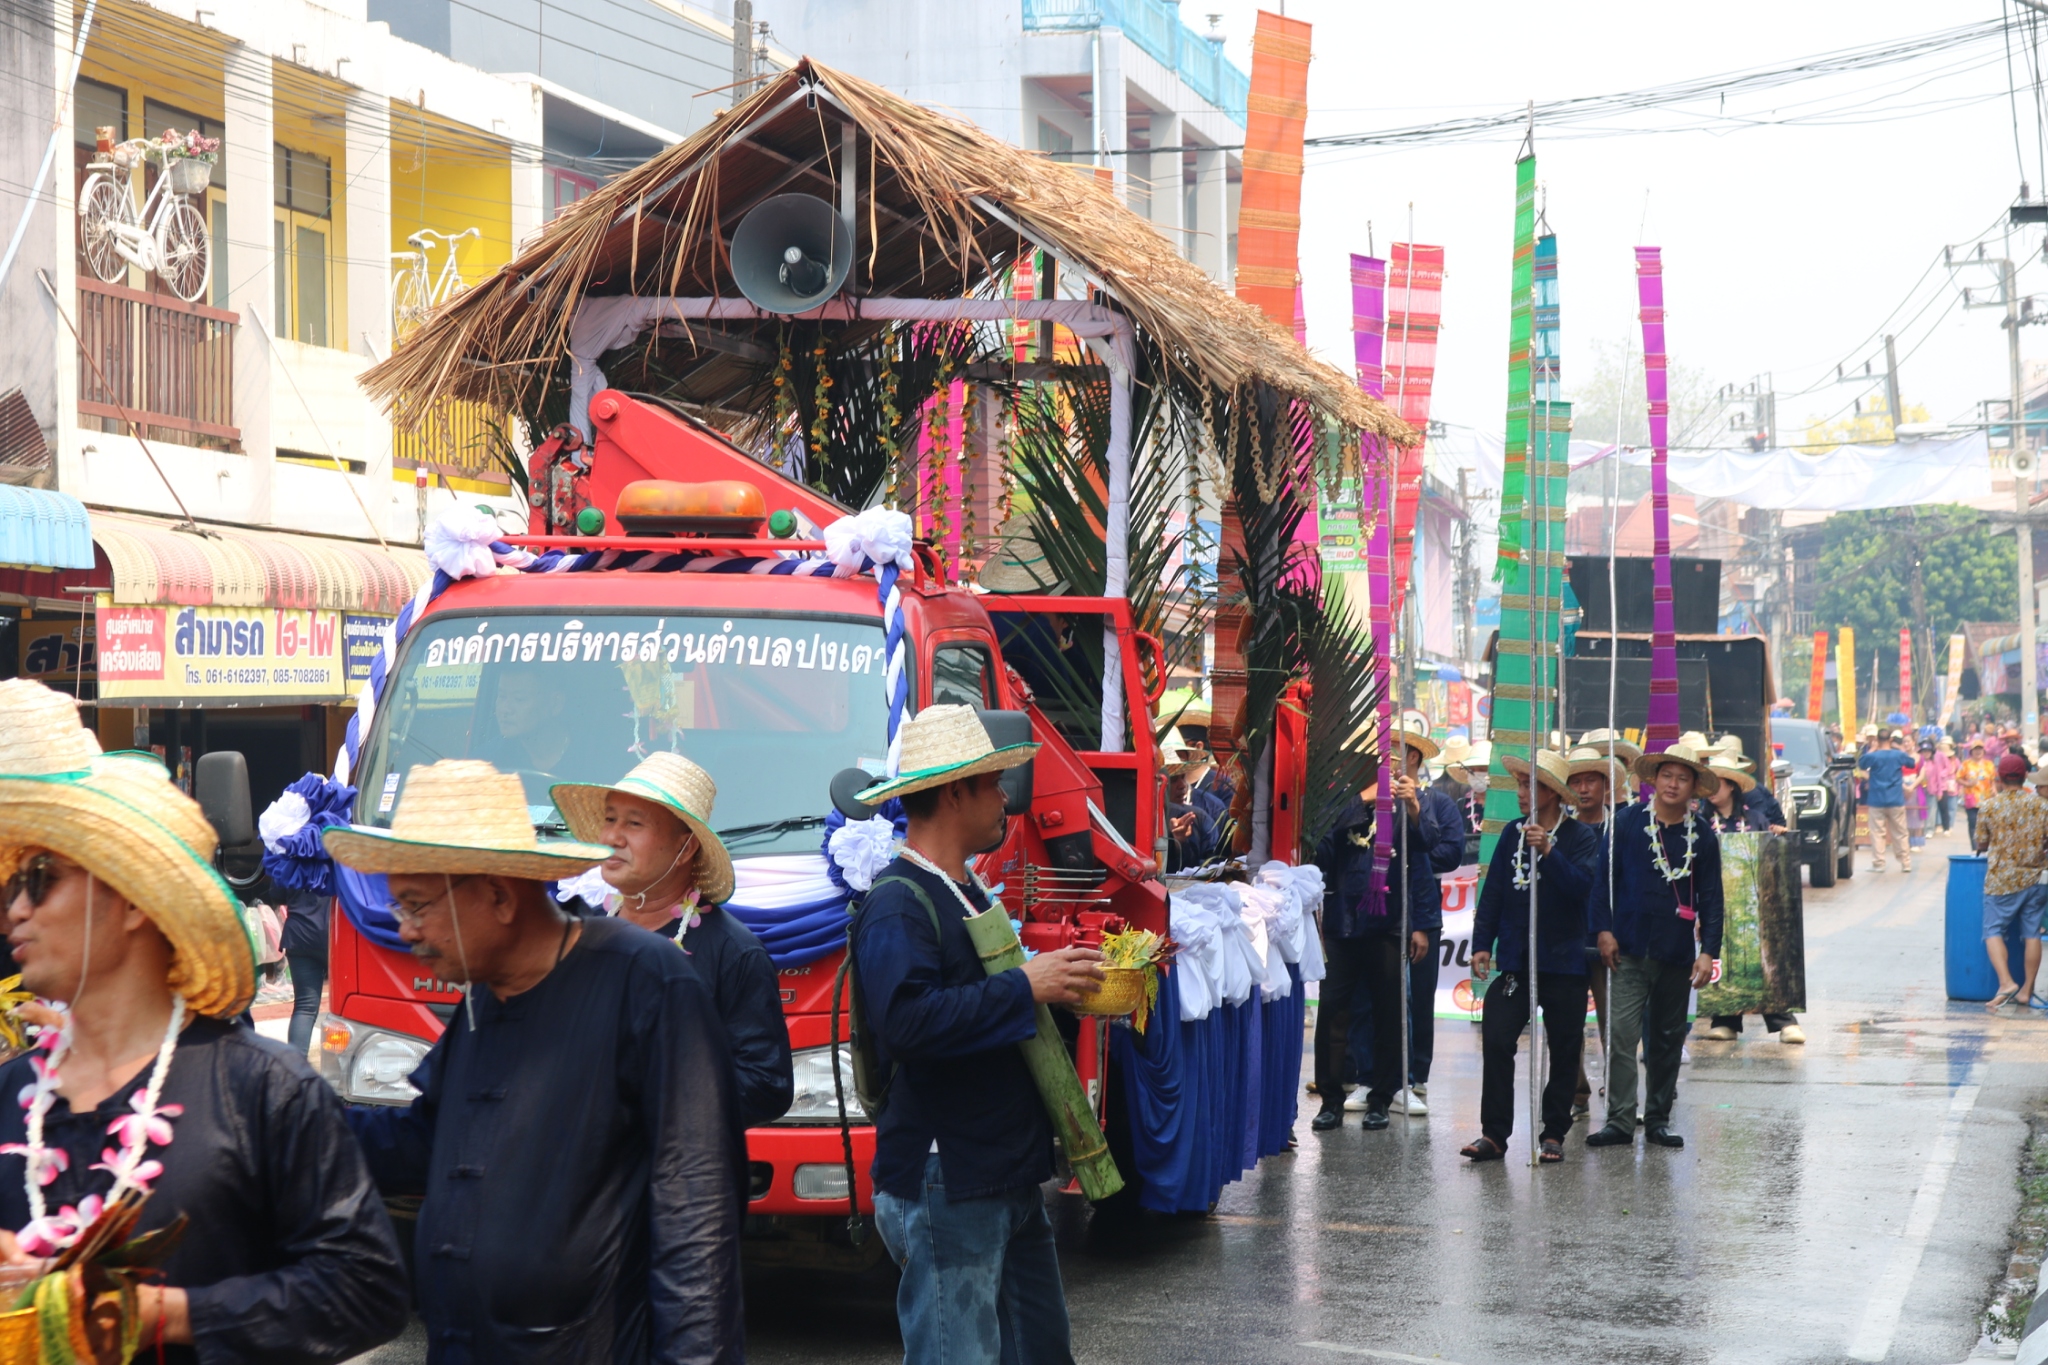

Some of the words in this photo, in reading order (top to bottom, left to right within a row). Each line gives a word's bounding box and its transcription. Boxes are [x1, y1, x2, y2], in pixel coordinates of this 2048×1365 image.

[106, 613, 154, 640] ศูนย์จำหน่าย
[175, 606, 264, 656] สามารถ
[100, 638, 162, 673] เครื่องเสียง
[206, 669, 269, 686] 061-6162397,
[273, 668, 330, 683] 085-7082861
[414, 977, 467, 994] HIN
